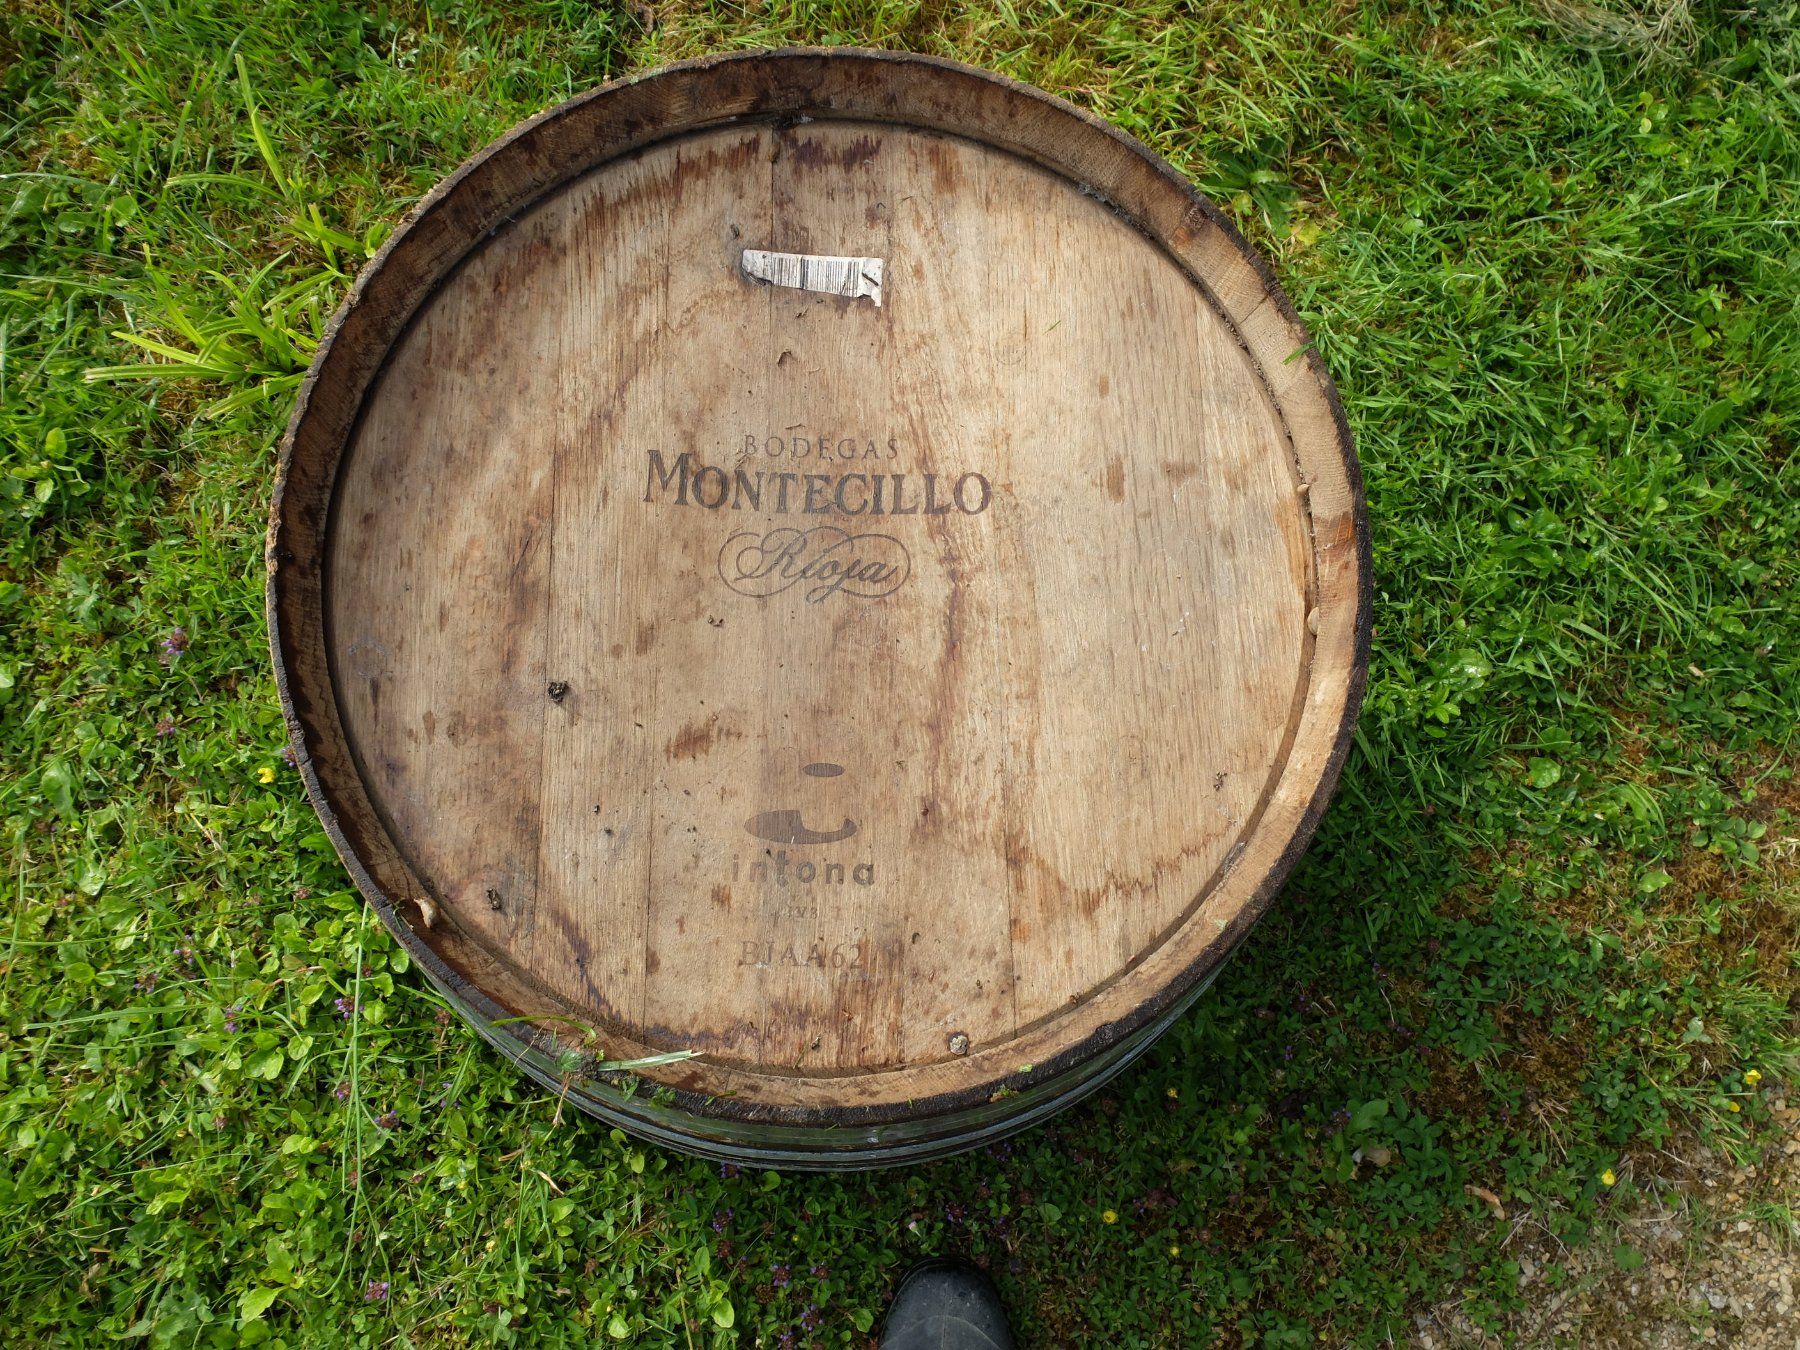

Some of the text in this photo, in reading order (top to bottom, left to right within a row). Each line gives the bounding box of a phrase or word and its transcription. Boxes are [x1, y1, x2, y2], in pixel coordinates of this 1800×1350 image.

[743, 434, 899, 460] BODEGAS
[643, 449, 992, 515] MONTECILLO
[718, 525, 911, 603] Rioja
[733, 851, 875, 886] intona
